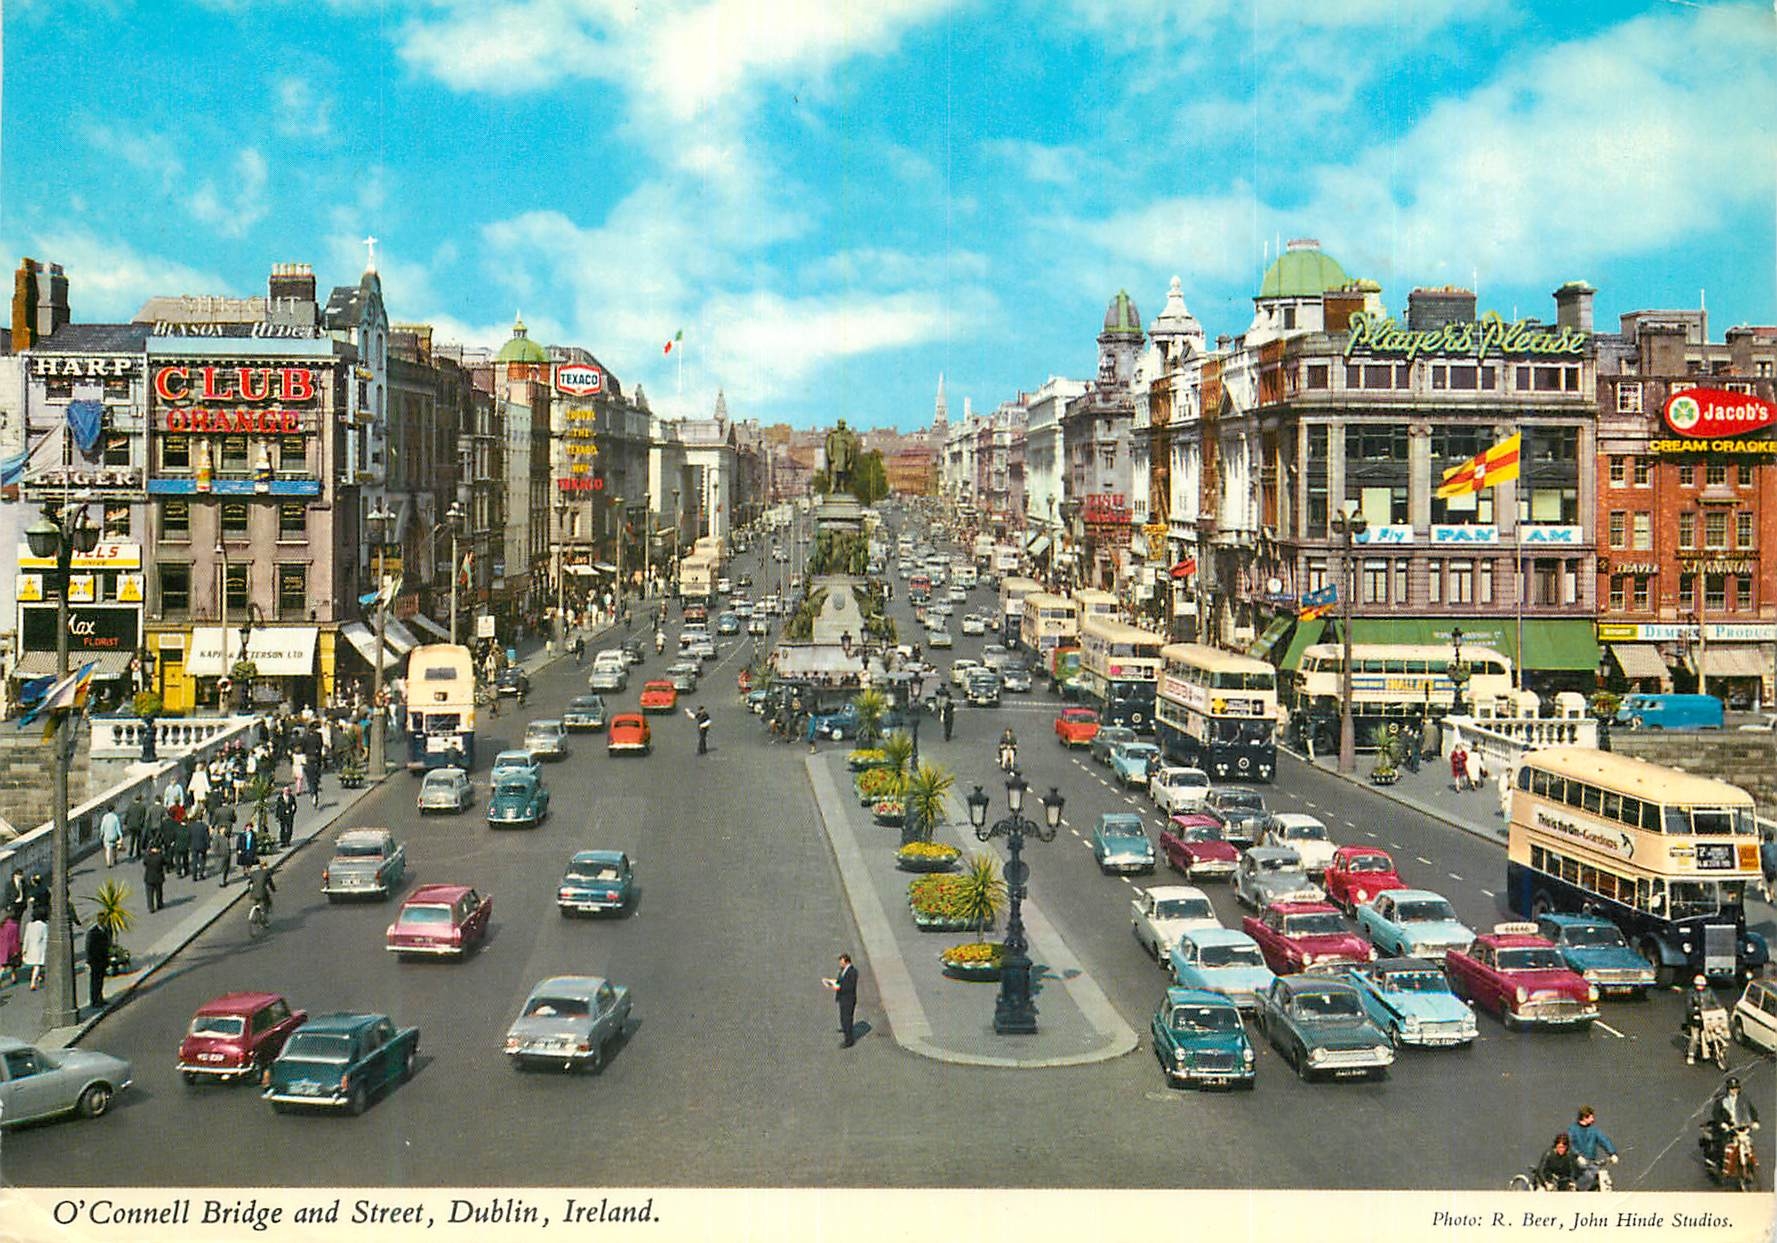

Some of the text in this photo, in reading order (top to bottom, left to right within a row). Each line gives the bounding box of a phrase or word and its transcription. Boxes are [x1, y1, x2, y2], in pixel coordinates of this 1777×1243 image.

[1478, 310, 1588, 359] Please
[36, 358, 132, 376] HARP
[155, 366, 315, 400] CLUB
[561, 374, 598, 385] TEXACO
[1704, 403, 1769, 421] Jacob's
[167, 408, 301, 433] ORANGE
[1650, 440, 1777, 453] CREAM CRACKE
[34, 472, 135, 485] LAGER
[557, 478, 604, 490] TEXACO
[1377, 527, 1573, 542] Fly PAN AM
[84, 637, 119, 648] FLORIST
